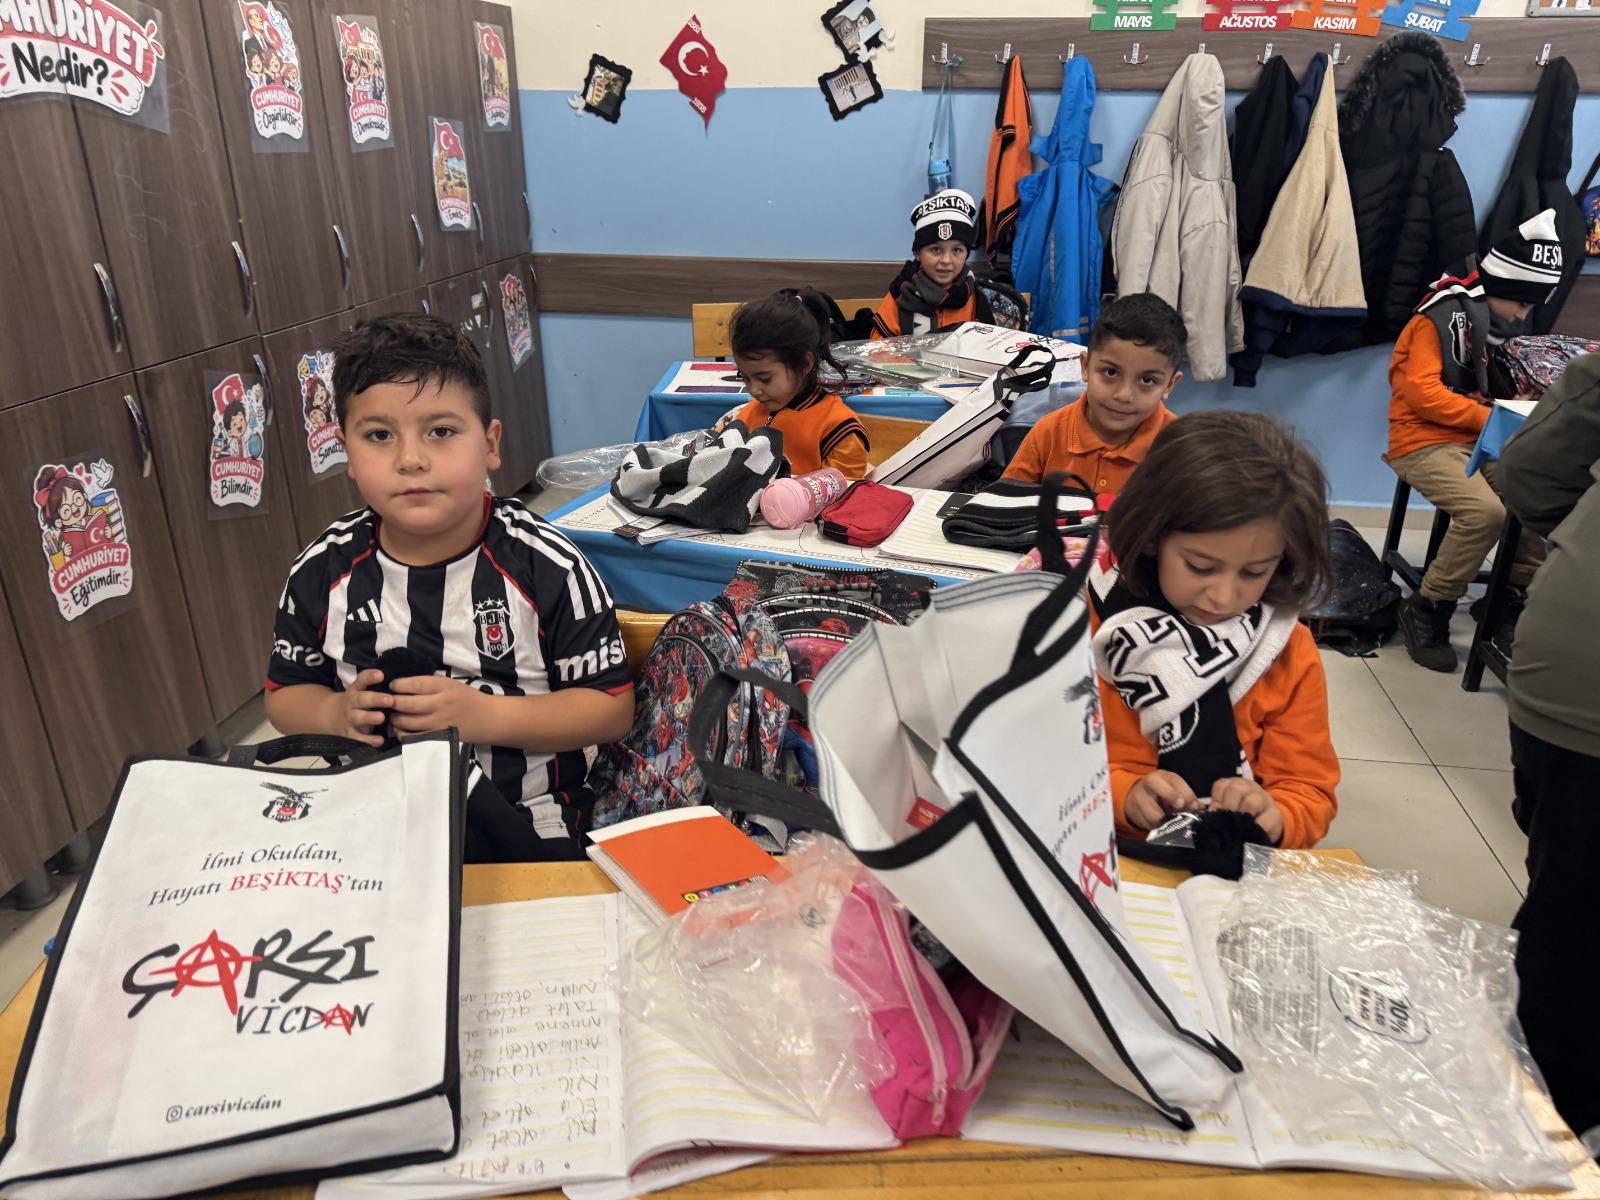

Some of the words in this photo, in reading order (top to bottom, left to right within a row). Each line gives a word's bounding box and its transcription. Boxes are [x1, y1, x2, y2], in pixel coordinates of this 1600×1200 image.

[1114, 15, 1153, 28] MAYIS
[1219, 13, 1277, 29] AĞUSTOS
[1313, 16, 1357, 30] KASIM
[1404, 12, 1446, 33] ŞUBAT
[11, 41, 109, 96] Nedir?
[255, 87, 300, 109] CUMHURİYET
[691, 96, 708, 114] 1938
[215, 459, 261, 479] CUMHURİYET
[57, 545, 126, 588] CUMHURİYET
[69, 571, 123, 607] Eğitimdir.
[480, 612, 506, 625] BJK
[486, 643, 508, 652] 1903
[200, 852, 244, 872] İlmi
[250, 842, 343, 864] Okuldan,
[147, 881, 222, 907] Hayatı
[227, 867, 384, 895] BEŞİKTAŞ'tan
[122, 929, 380, 1019] ÇARŞI
[234, 998, 375, 1036] VİCDAN
